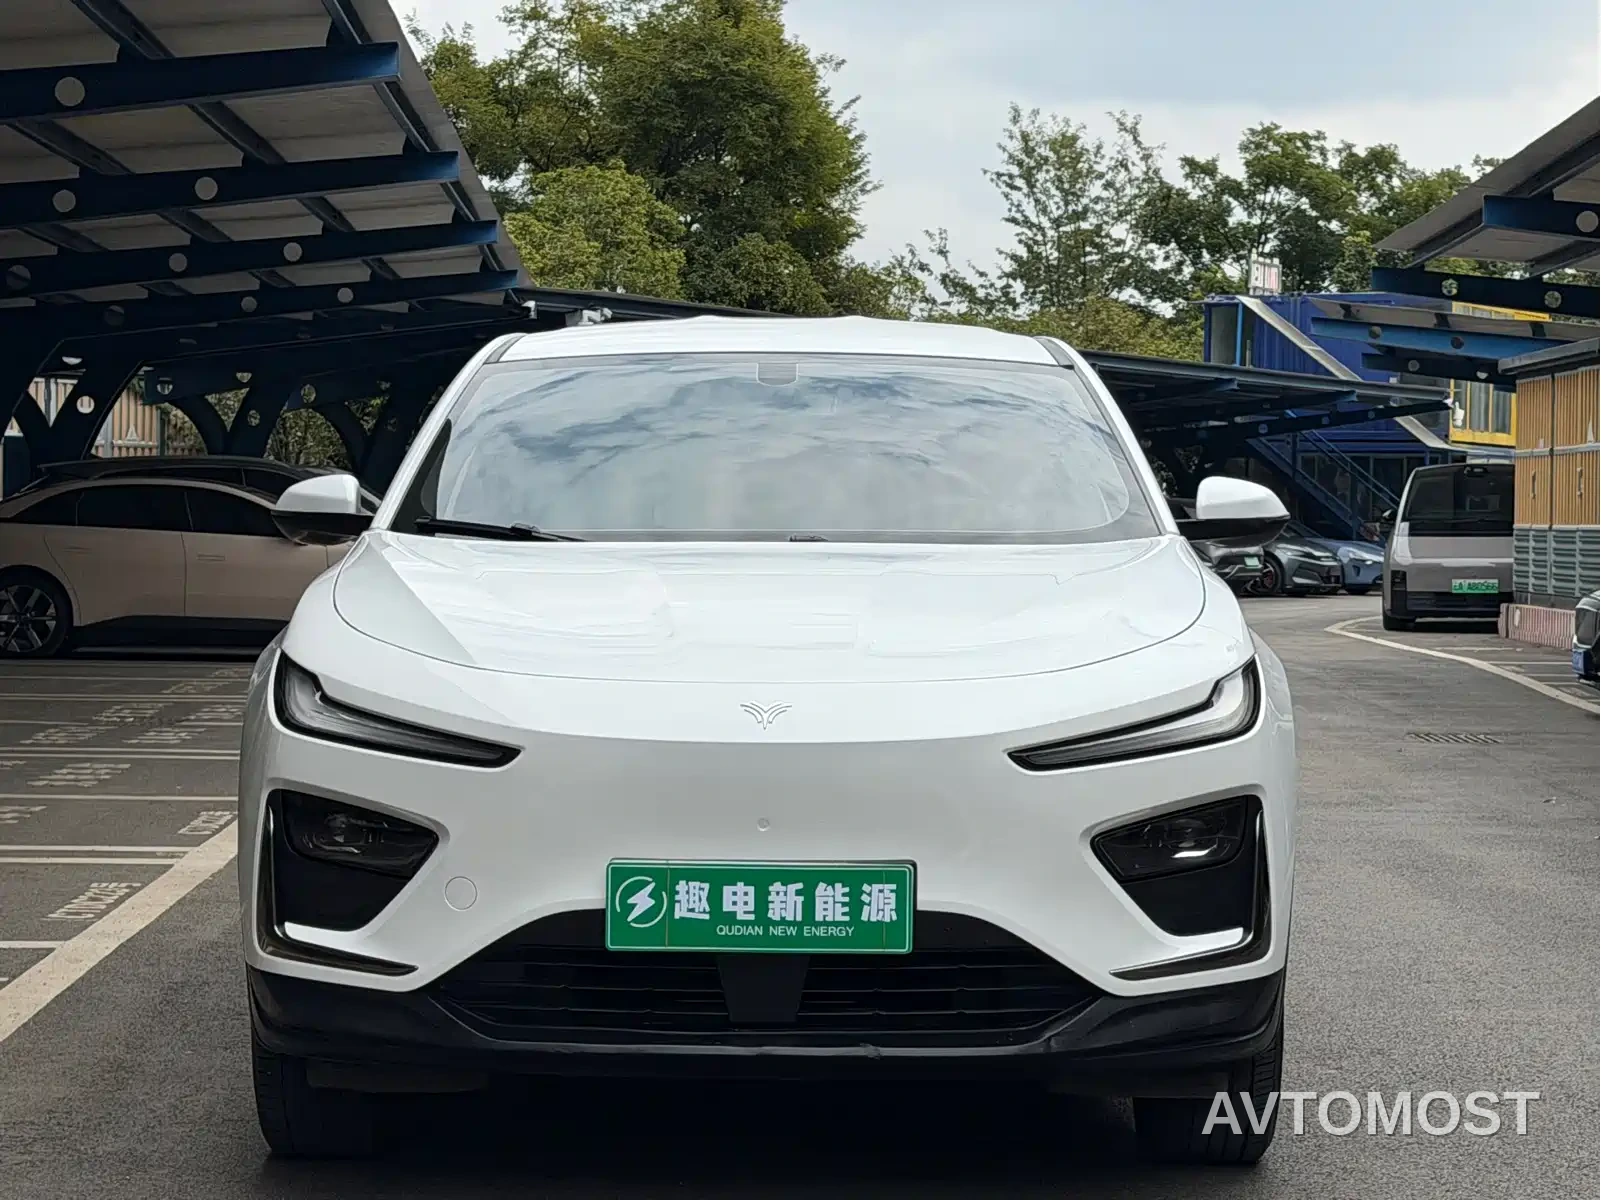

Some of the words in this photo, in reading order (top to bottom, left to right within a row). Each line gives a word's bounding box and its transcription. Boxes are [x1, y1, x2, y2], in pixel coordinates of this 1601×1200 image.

[674, 880, 898, 923] 趣电新能源
[716, 924, 763, 937] QUDIAN
[769, 925, 798, 937] NEW
[803, 926, 855, 938] ENERGY
